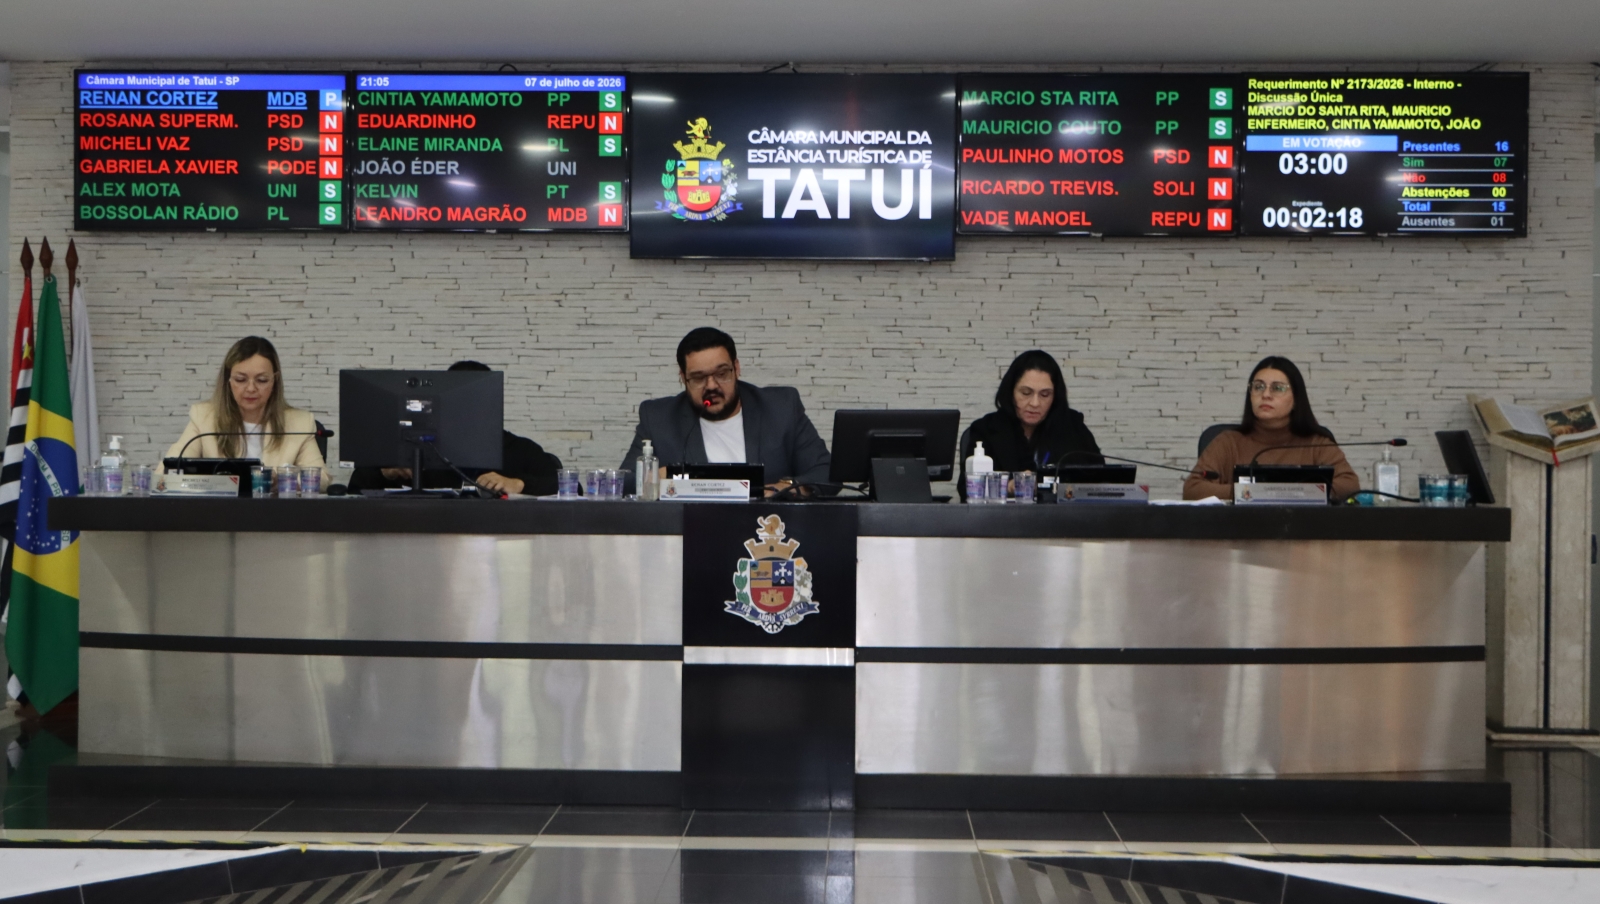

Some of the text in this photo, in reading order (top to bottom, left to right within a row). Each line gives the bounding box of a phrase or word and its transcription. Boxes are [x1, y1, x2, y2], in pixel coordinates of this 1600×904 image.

[86, 76, 124, 85] Câmara
[127, 76, 175, 86] Municipal
[177, 77, 190, 85] de
[193, 76, 217, 85] Tatuí
[226, 77, 240, 86] SP
[361, 78, 621, 88] 21:05 07 de julho de 2026
[1249, 79, 1328, 92] Requerimento
[1331, 79, 1345, 89] Nº
[1347, 79, 1404, 89] 2173/2026
[1414, 80, 1454, 89] Interno
[80, 91, 336, 106] RENAN CORTEZ MDB P
[358, 92, 616, 107] CINTIA YAMAMOTO PP S
[962, 91, 1227, 106] MARCIO STA RITA PP S
[1248, 90, 1343, 103] Discussão Única
[1248, 106, 1451, 118] MARCIO DO SANTA RITA, MAURICIO
[80, 114, 337, 128] ROSANA SUPERM. PSD N
[358, 114, 617, 130] EDUARDINHO REPU N
[963, 120, 1226, 135] MAURICIO COUTO PP S
[1248, 117, 1481, 132] ENFERMEIRO, CINTIA YAMAMOTO, JOÃO
[748, 127, 932, 145] CÂMARA MUNICIPAL DA
[1283, 135, 1362, 150] EM VOTAÇÃO
[80, 137, 337, 151] MICHELI VAZ PSD N
[358, 138, 616, 152] ELAINE MIRANDA PL S
[1403, 142, 1509, 154] Presentes 16
[748, 146, 932, 164] ESTÂNCIA TURÍSTICA DE
[962, 149, 1227, 164] PAULINHO MOTOS PSD N
[1403, 157, 1507, 167] Sim 07
[80, 160, 337, 174] GABRIELA XAVIER PODE N
[356, 157, 576, 175] JOÃO ÉDER UNI
[1279, 154, 1348, 174] 03:00
[1403, 173, 1506, 183] Não 08
[80, 183, 336, 198] ALEX MOTA UNI S
[356, 184, 616, 199] KELVIN PT S
[748, 162, 932, 220] TATUÍ
[962, 180, 1226, 196] RICARDO TREVIS. SOLI N
[1402, 187, 1506, 199] Abstenções 00
[80, 203, 336, 221] BOSSOLAN RÁDIO PL S
[356, 204, 617, 222] LEANDRO MAGRÃO MDB N
[1403, 201, 1505, 212] Total 15
[962, 211, 1226, 227] VADE MANOEL REPU N
[1262, 208, 1363, 228] 00:02:18
[1402, 216, 1504, 226] Ausentes 01
